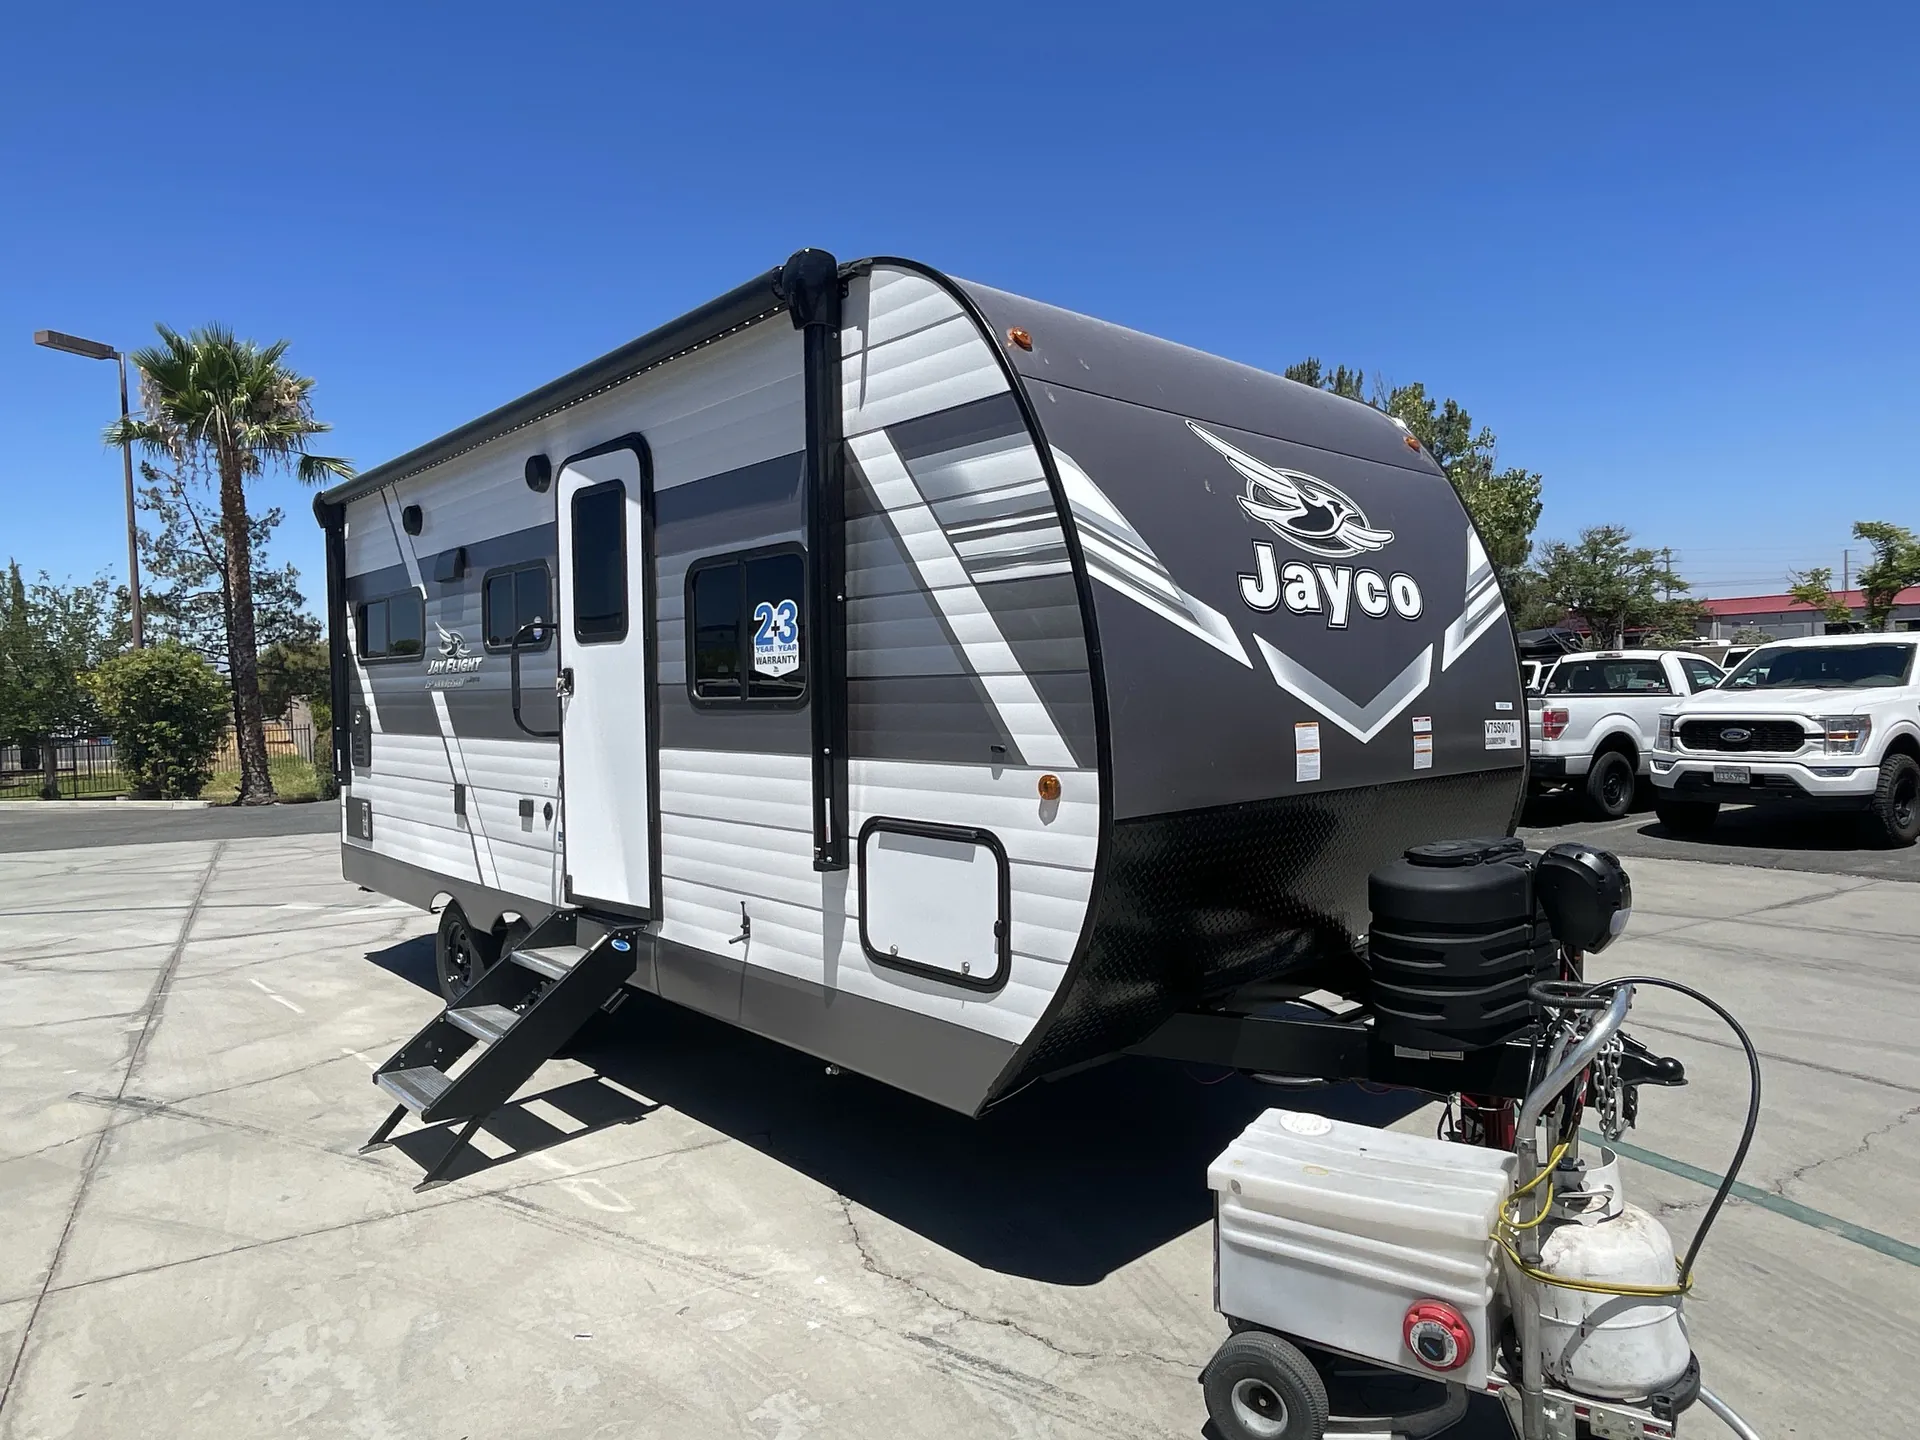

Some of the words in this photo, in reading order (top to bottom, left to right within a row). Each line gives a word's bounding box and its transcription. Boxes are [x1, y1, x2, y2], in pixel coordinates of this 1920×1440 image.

[1238, 541, 1424, 629] Jayco
[427, 660, 446, 675] JAY
[446, 657, 483, 673] FLIGHT
[756, 655, 797, 665] WARRANTY
